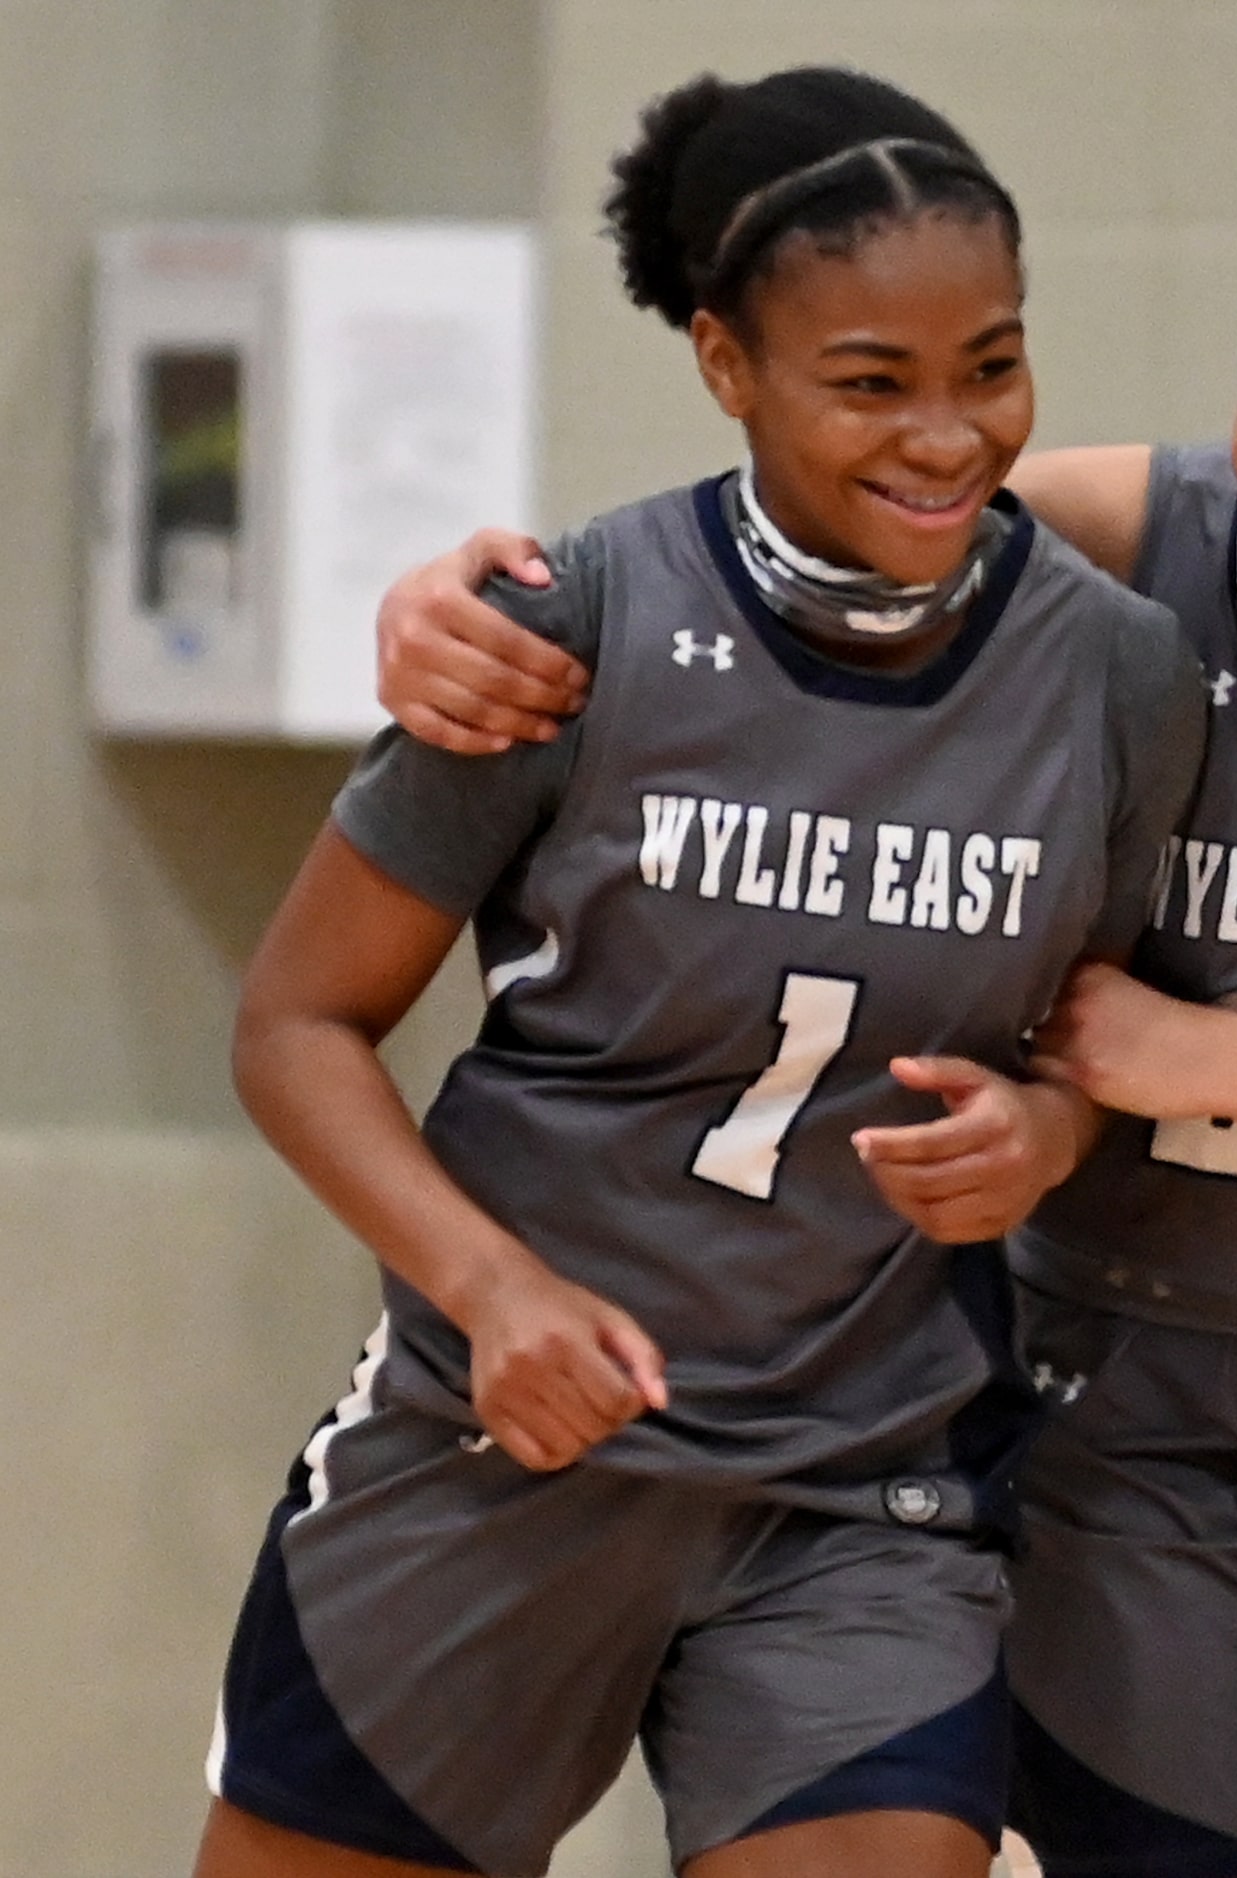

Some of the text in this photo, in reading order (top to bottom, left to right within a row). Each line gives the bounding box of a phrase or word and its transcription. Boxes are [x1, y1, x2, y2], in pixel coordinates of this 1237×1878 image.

[639, 794, 1042, 938] WYLIE EAST
[690, 972, 859, 1200] 1
